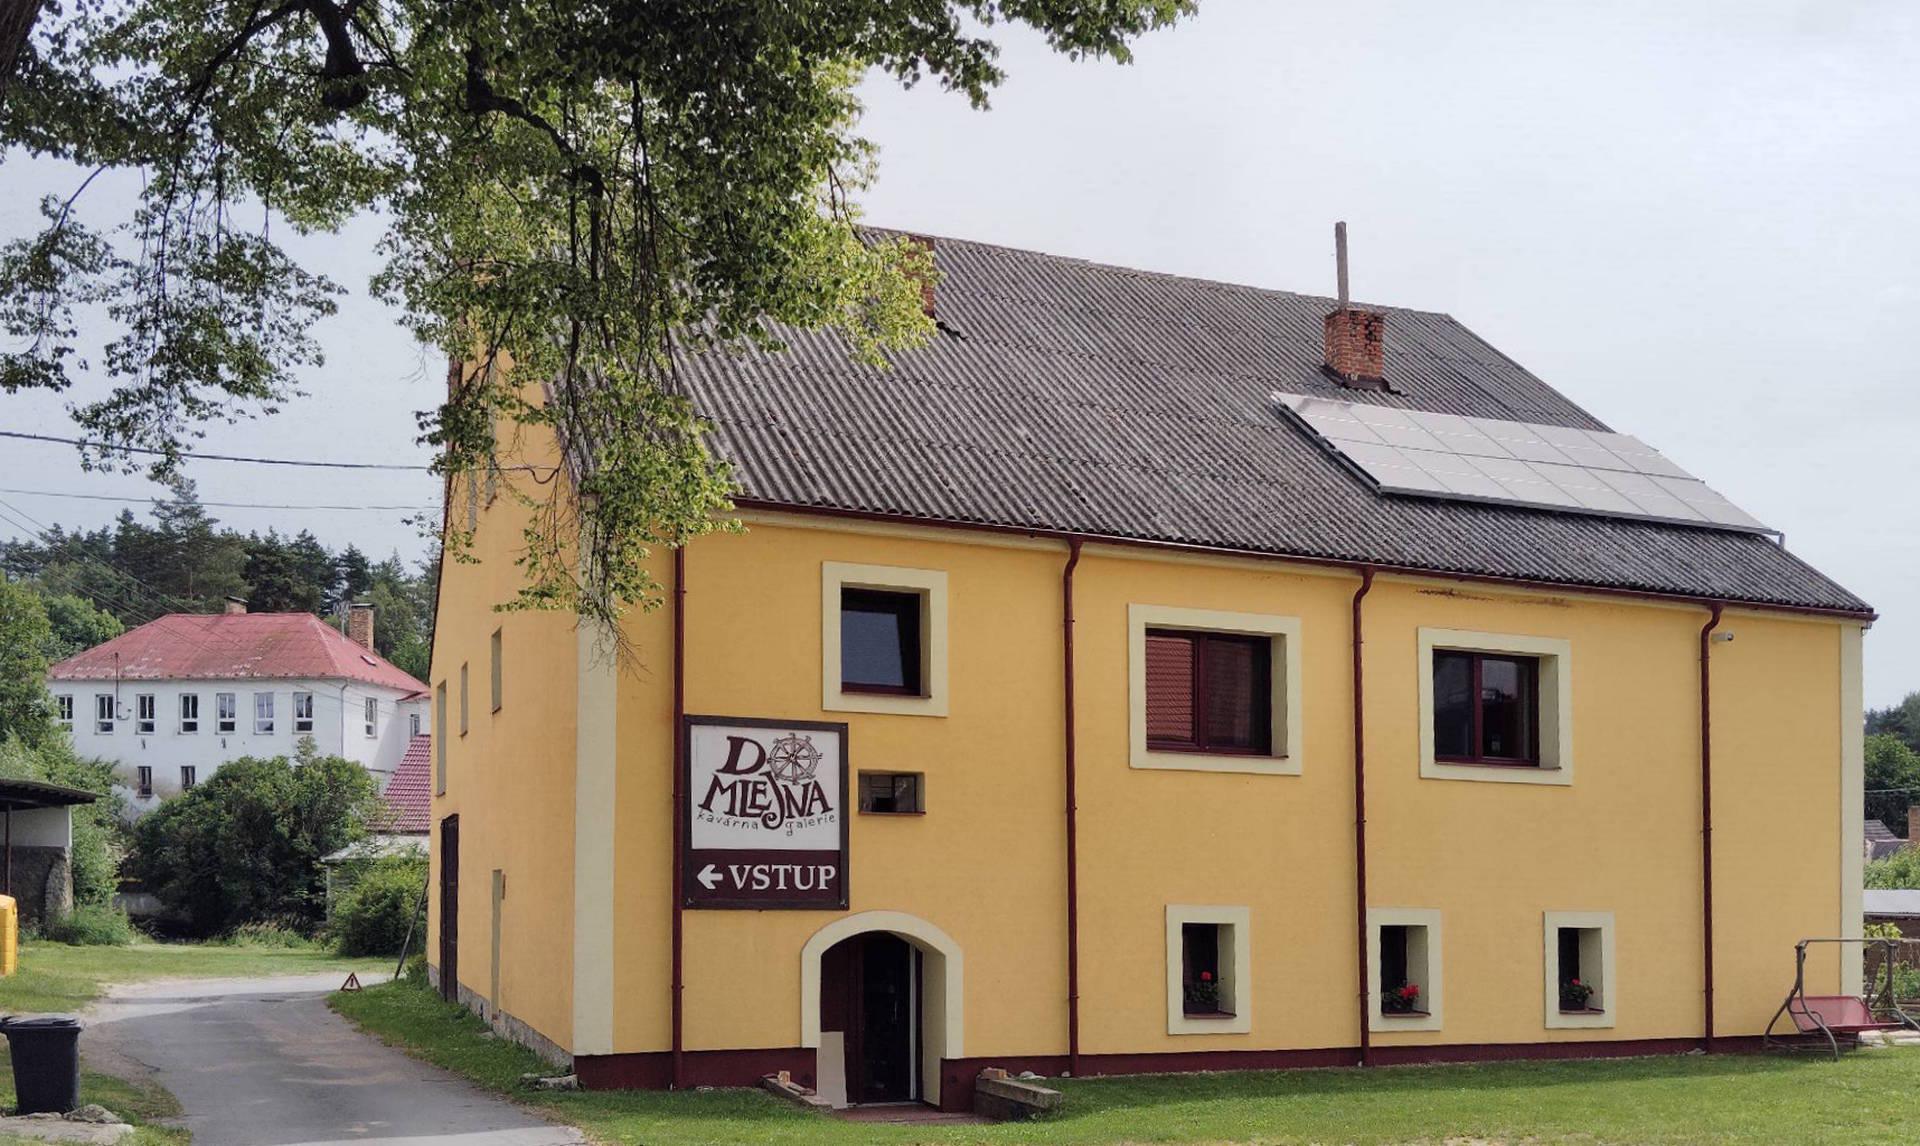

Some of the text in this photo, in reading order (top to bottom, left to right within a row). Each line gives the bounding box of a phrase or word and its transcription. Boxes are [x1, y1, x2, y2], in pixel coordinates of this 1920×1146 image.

[698, 771, 834, 830] MLEJNA
[696, 812, 836, 837] kavárna galerie
[728, 864, 836, 890] VSTUP
